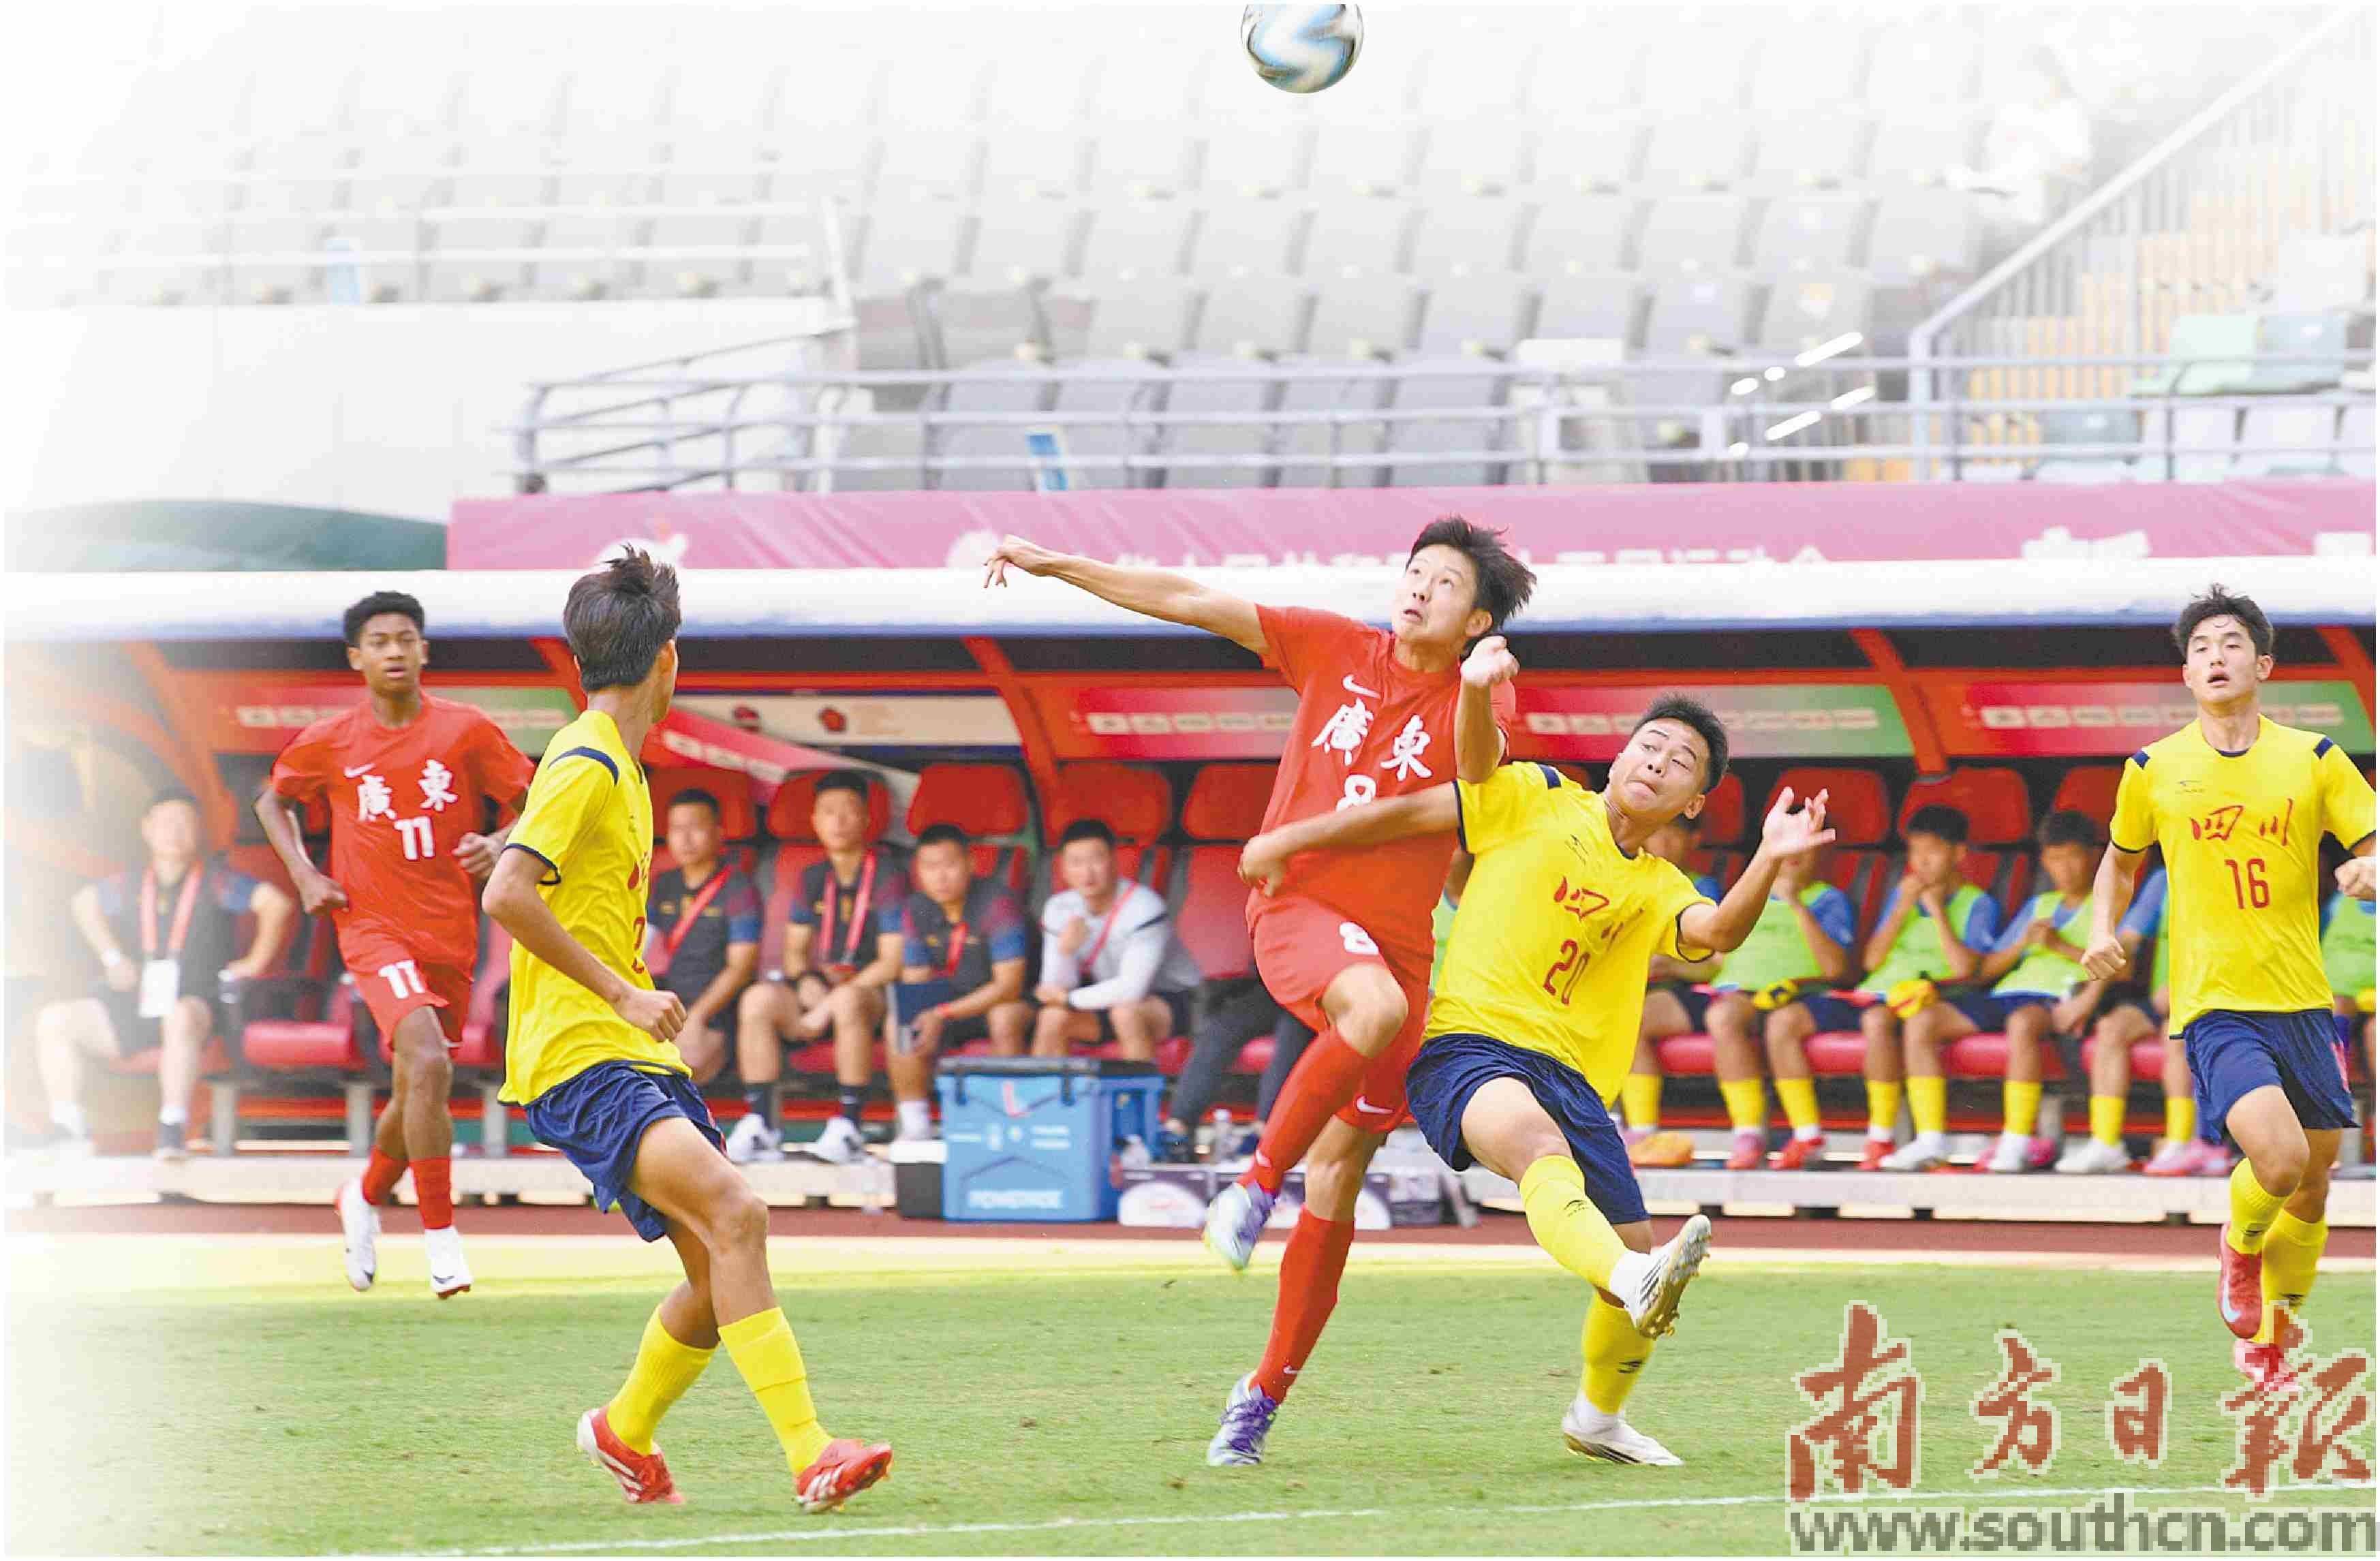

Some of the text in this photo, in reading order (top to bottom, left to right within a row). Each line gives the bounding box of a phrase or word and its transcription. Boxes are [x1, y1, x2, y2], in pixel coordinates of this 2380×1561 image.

[394, 816, 435, 861] 11
[2189, 797, 2294, 846] 四川
[2224, 858, 2271, 910] 16
[1339, 921, 1380, 955] 8
[377, 959, 426, 1000] 11
[1542, 938, 1592, 1006] 20
